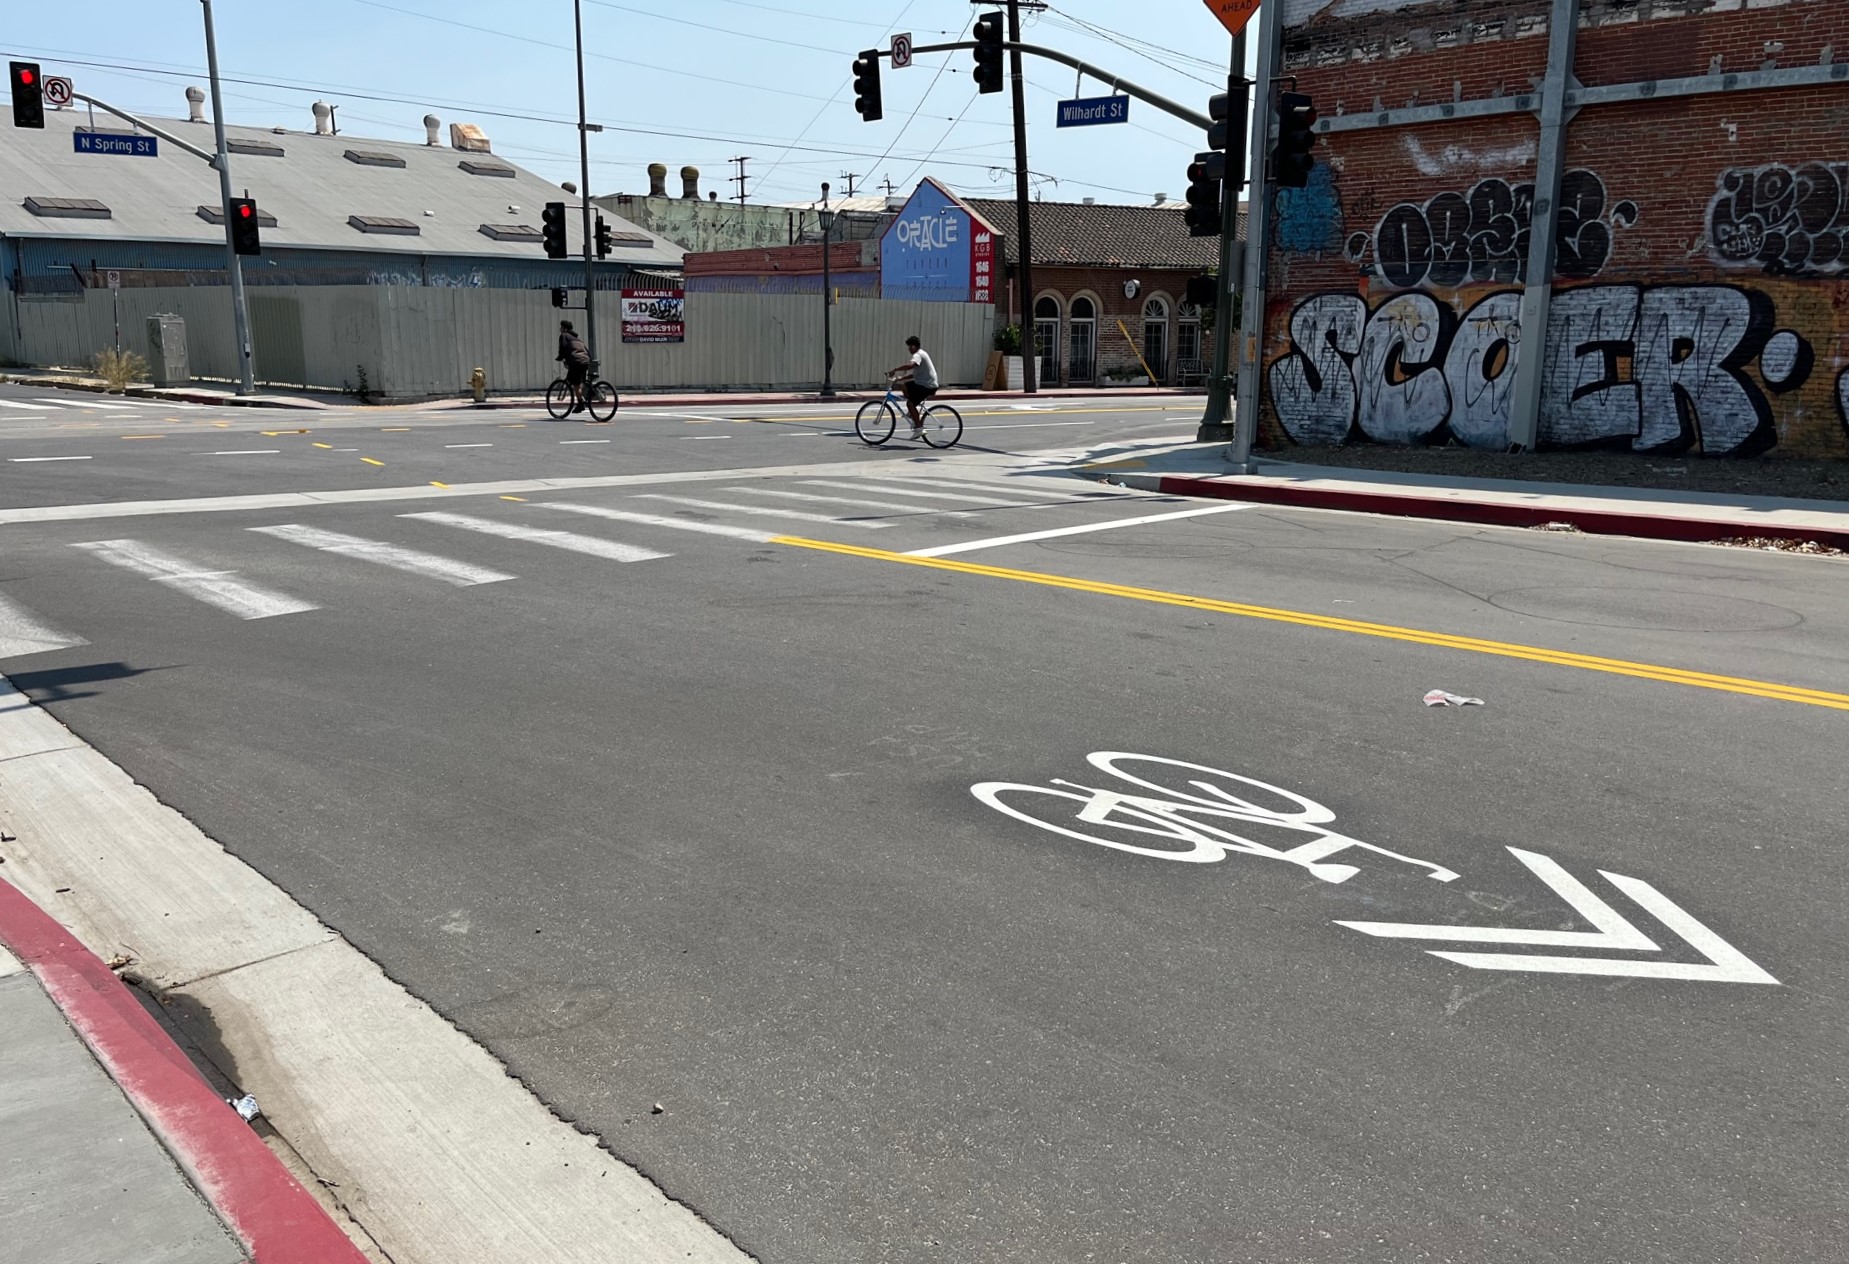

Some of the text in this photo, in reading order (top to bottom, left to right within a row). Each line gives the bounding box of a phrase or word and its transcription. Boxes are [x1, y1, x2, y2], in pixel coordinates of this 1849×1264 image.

[1221, 0, 1252, 13] AHEAD
[1063, 102, 1122, 120] Wilhardt St
[81, 137, 150, 154] N Spring St
[897, 215, 957, 251] ORACLE
[975, 243, 990, 252] KGB
[639, 301, 678, 313] DAUM
